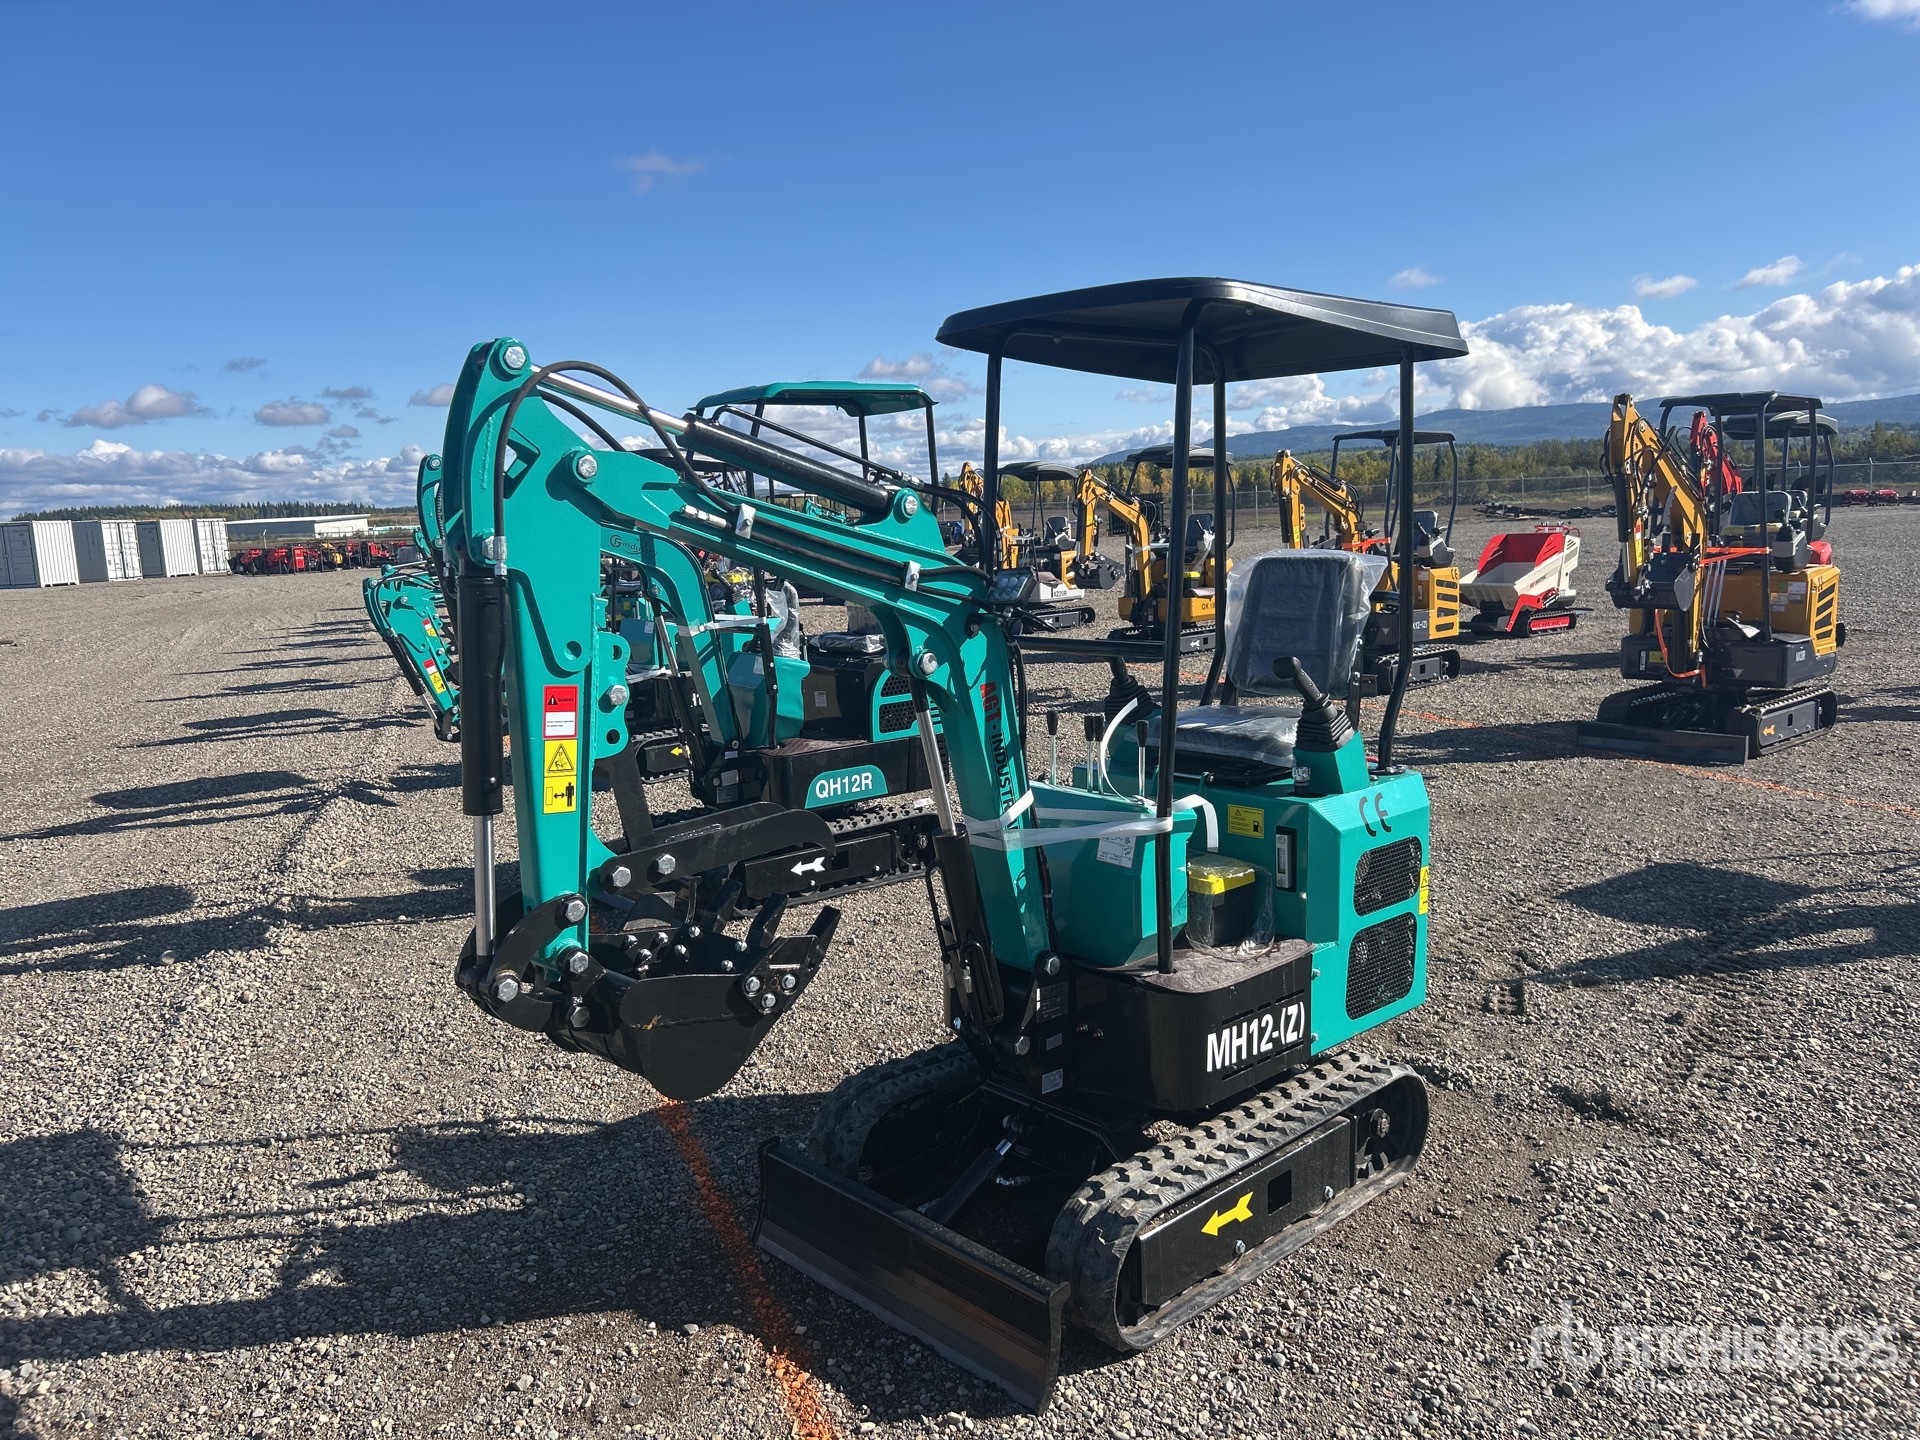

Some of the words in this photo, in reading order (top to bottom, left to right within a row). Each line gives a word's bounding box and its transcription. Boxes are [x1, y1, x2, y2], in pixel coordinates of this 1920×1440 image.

[980, 682, 1001, 725] AGT
[815, 771, 873, 799] QH12R
[1359, 792, 1392, 837] CE
[1206, 1001, 1305, 1073] MH12-(Z)
